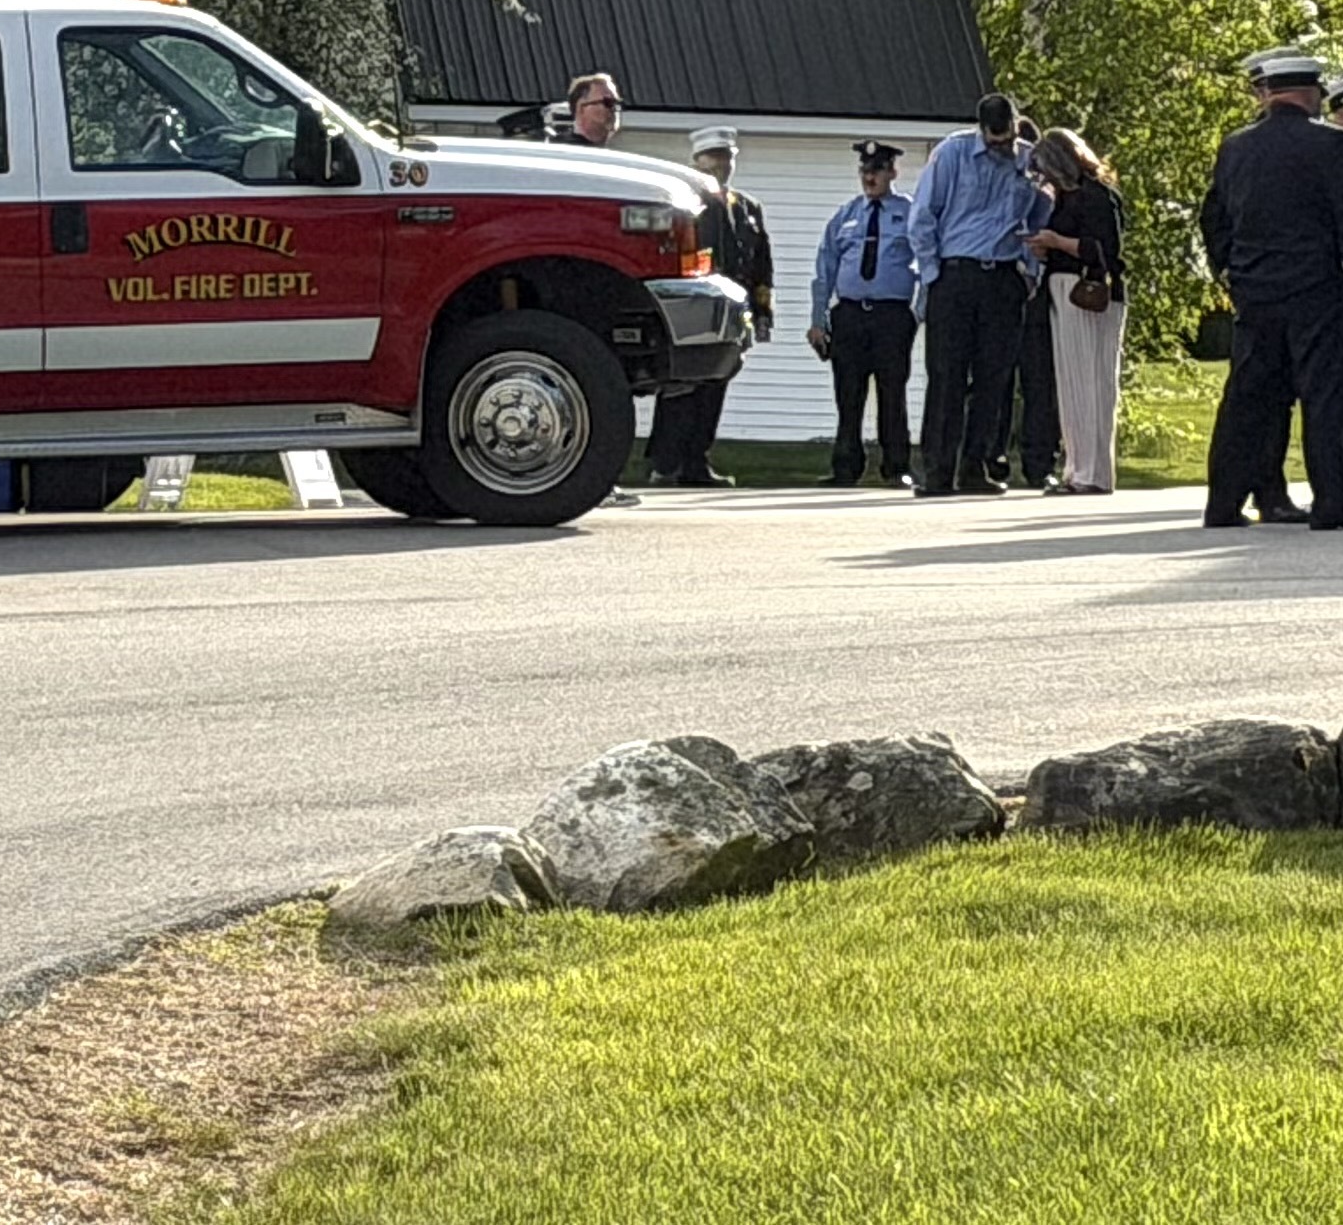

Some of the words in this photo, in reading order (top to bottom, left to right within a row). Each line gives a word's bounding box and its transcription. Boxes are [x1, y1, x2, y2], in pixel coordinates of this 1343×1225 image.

[388, 160, 430, 189] 30
[123, 212, 298, 263] MORRILL
[107, 276, 170, 303] VOL.
[173, 274, 237, 301] FIRE
[242, 272, 320, 299] DEPT.
